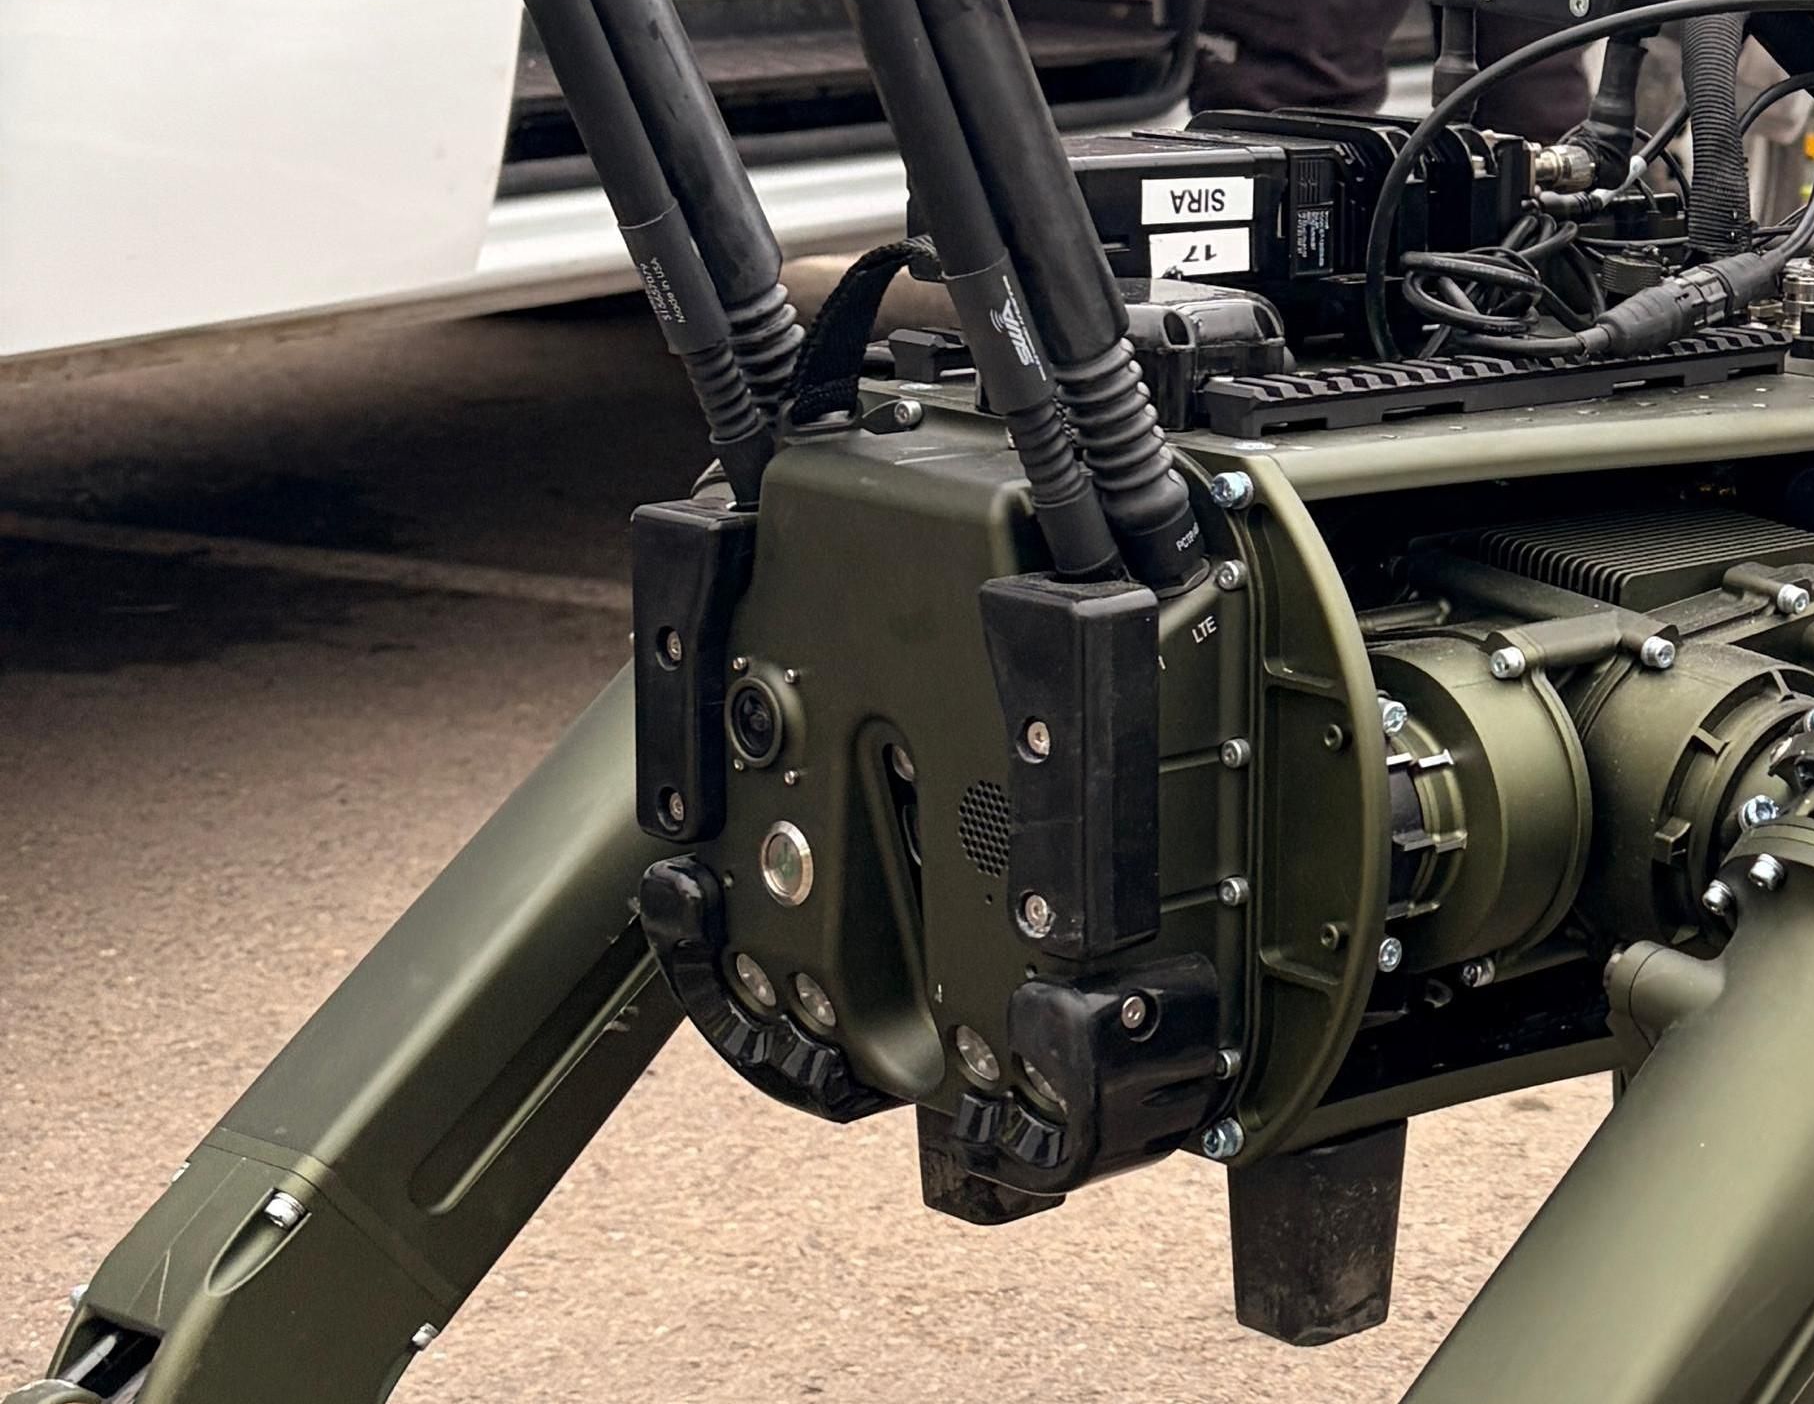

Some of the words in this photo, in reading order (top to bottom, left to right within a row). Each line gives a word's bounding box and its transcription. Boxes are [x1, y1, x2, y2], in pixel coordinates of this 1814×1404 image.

[1169, 187, 1226, 215] SIRA
[1181, 243, 1218, 264] 17
[1191, 615, 1217, 644] LTE
